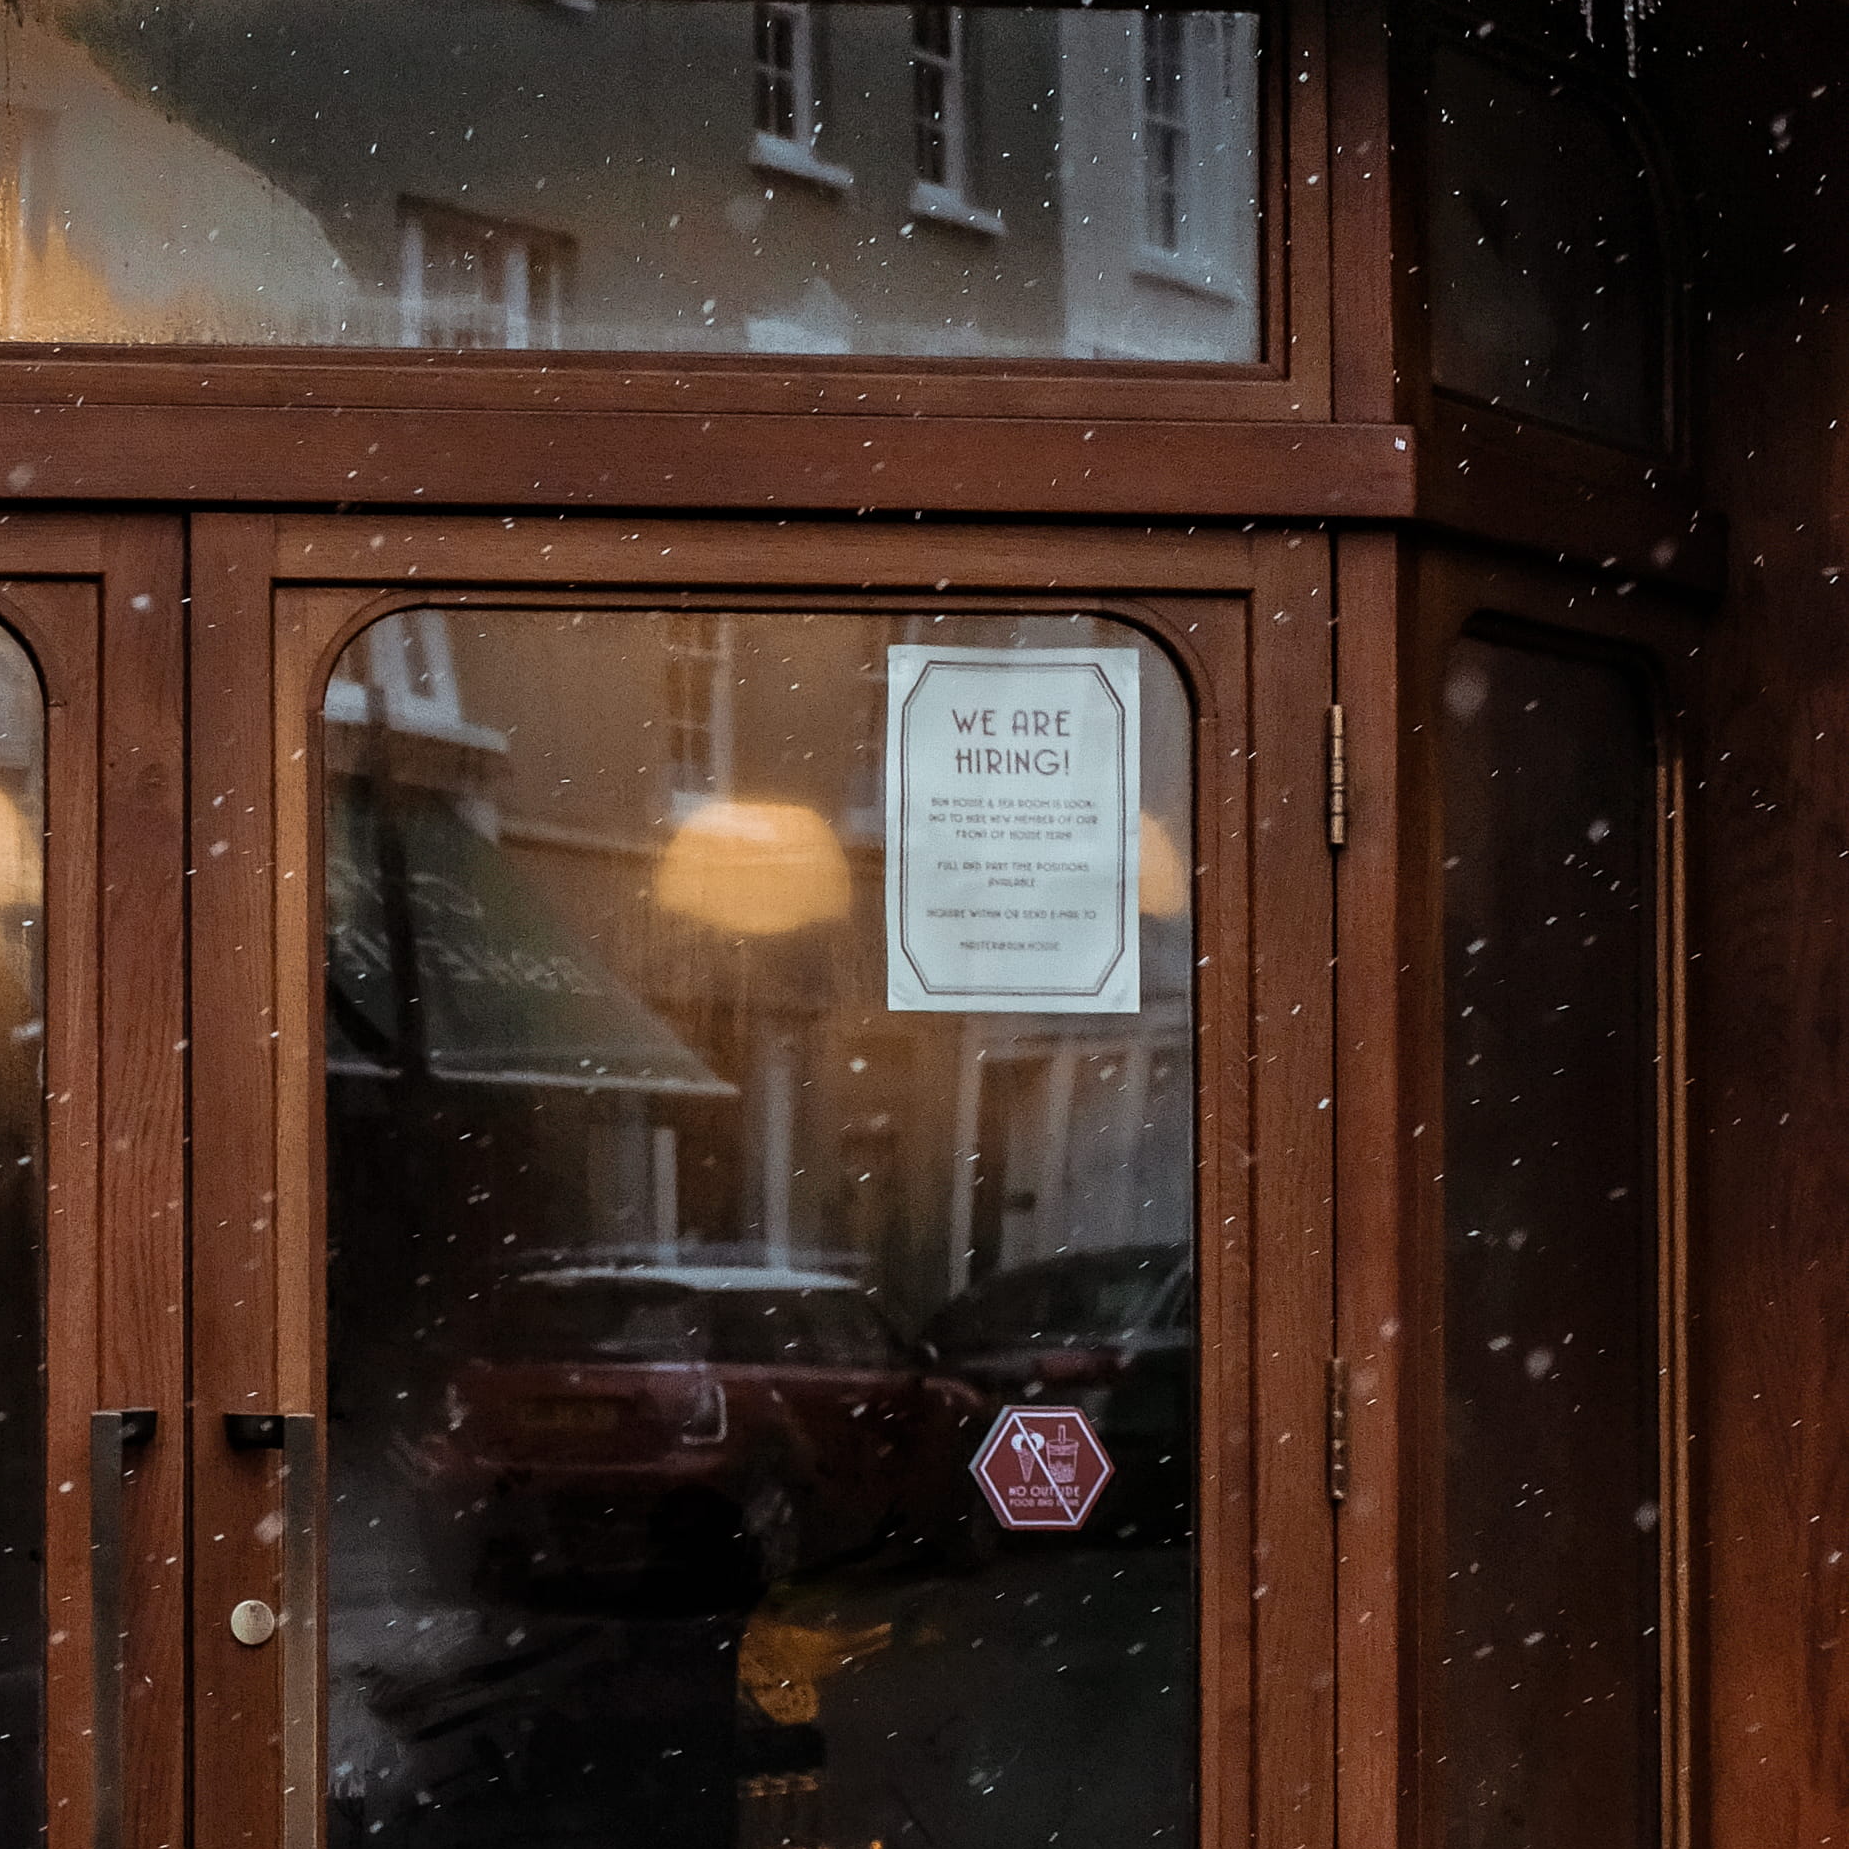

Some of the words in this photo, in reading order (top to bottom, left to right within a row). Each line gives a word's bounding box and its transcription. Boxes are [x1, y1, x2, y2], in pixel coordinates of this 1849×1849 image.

[952, 709, 996, 736] WE
[1012, 710, 1071, 737] ARE
[955, 749, 1069, 776] HIRING!
